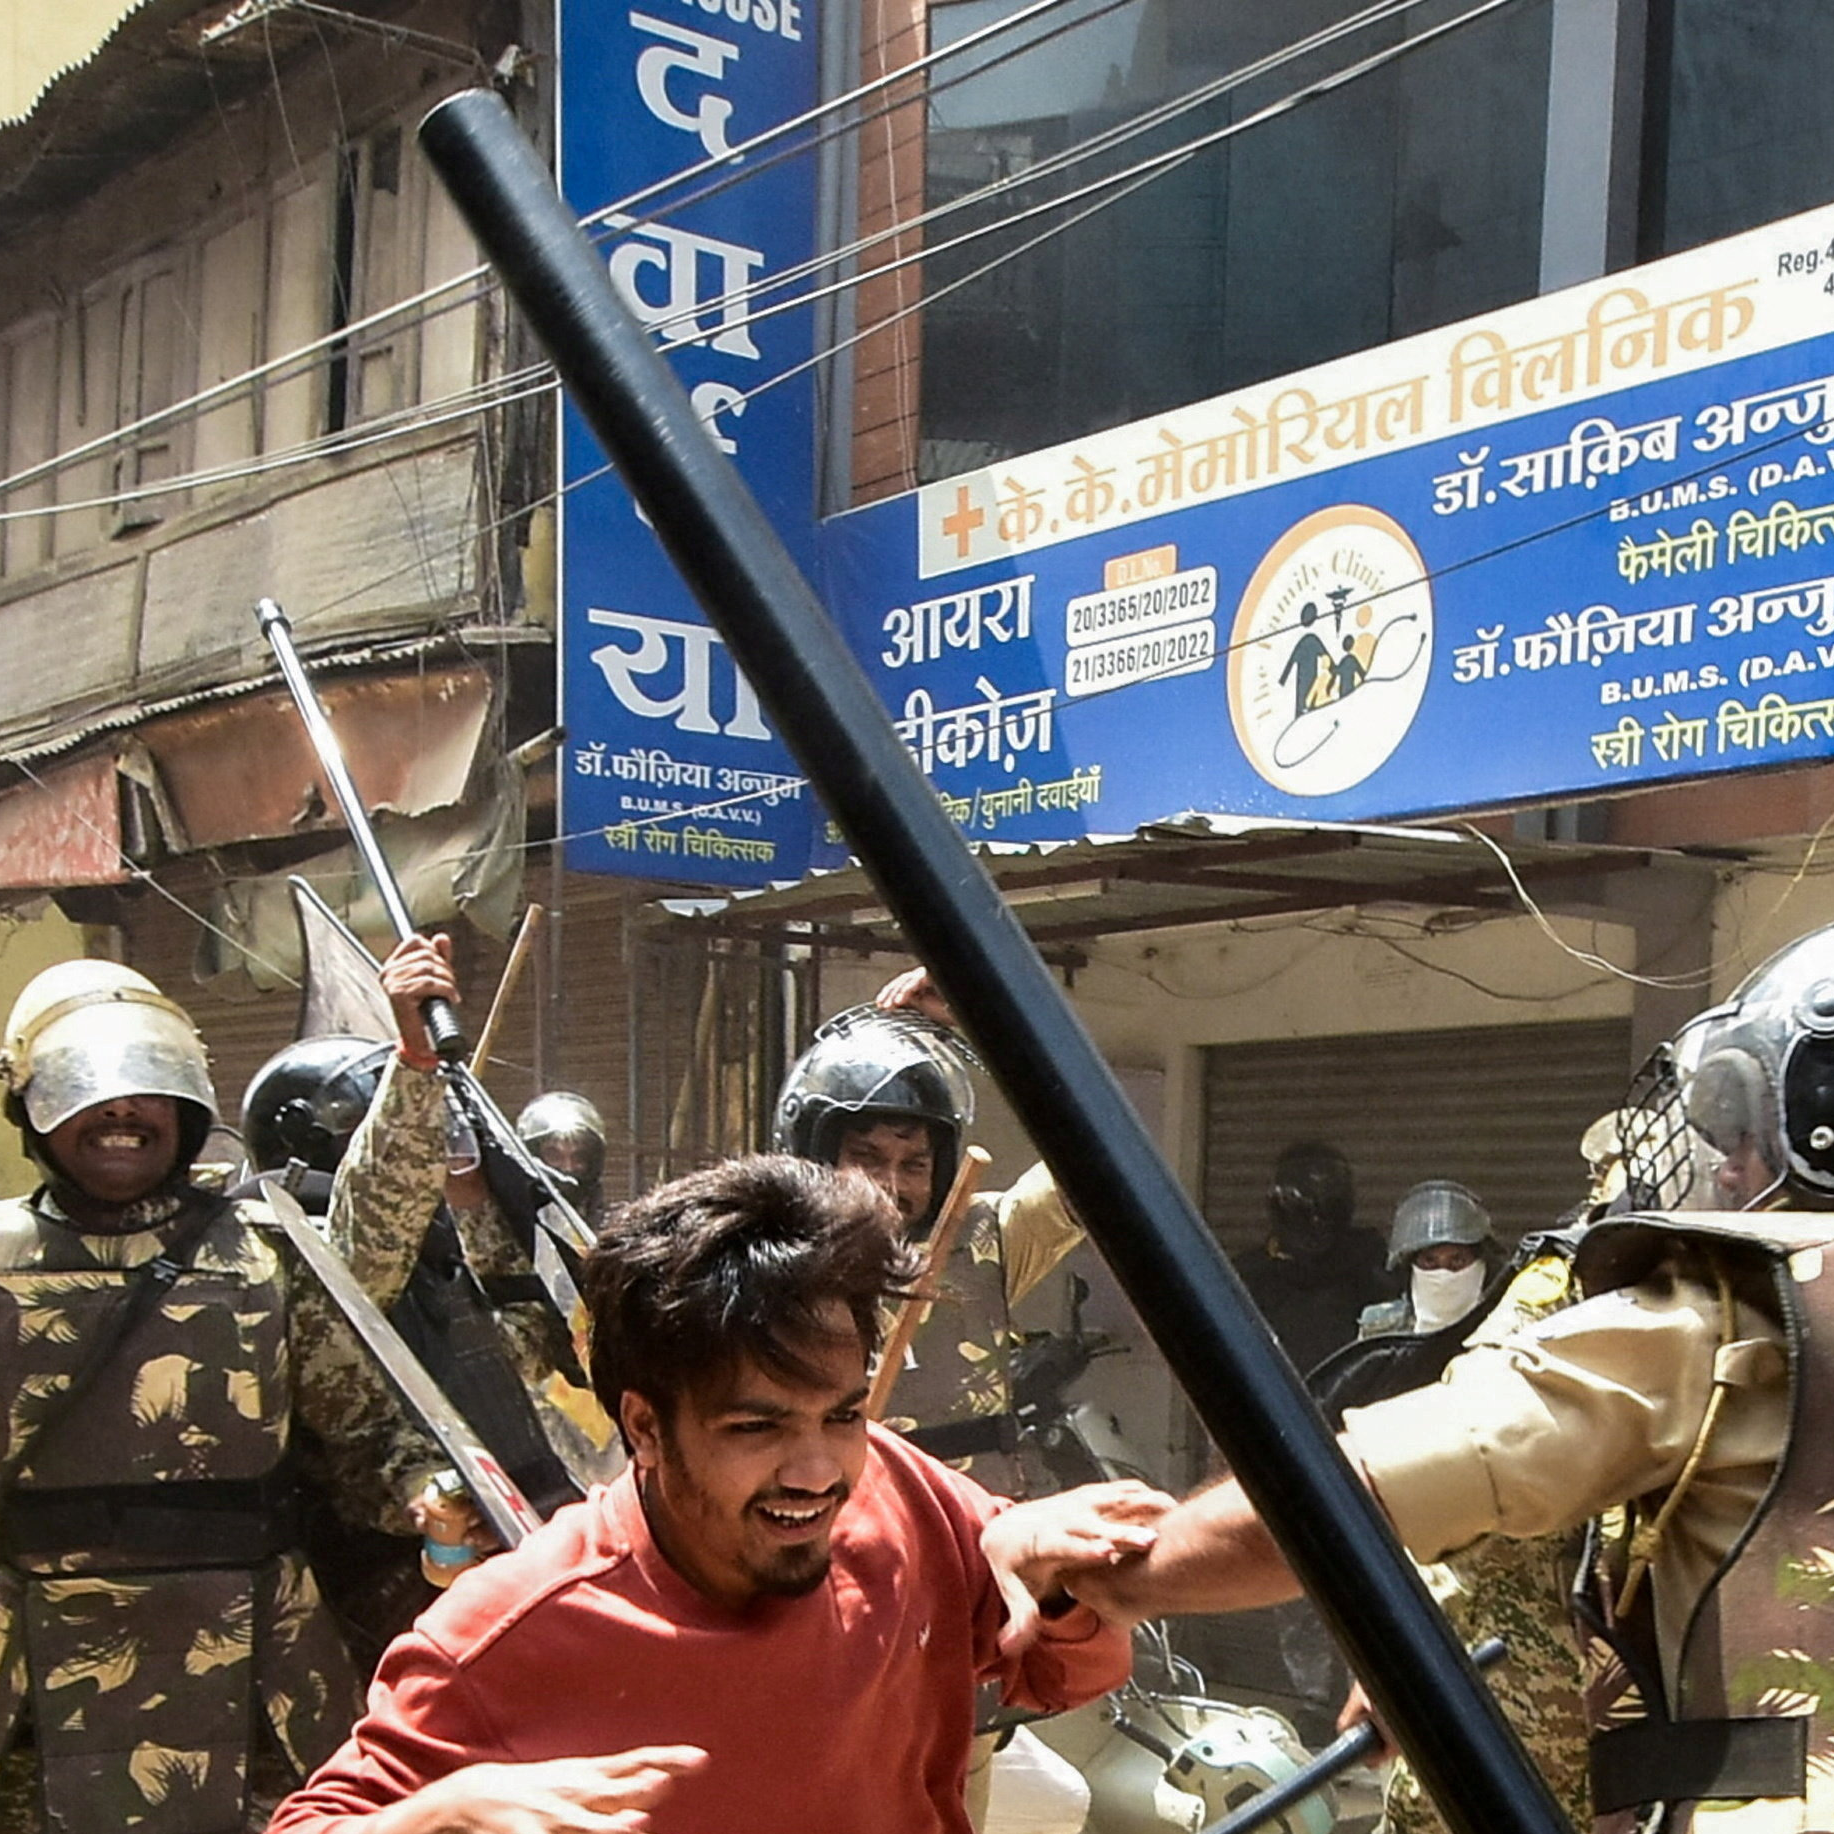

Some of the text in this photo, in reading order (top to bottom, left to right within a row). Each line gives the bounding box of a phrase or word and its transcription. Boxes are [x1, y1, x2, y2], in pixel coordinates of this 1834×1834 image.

[1609, 475, 1738, 523] B.U.M.S.
[1617, 519, 1718, 585] फैमेली
[881, 574, 1036, 668] आयरा
[1073, 577, 1210, 633] 20/3365/20/2022
[1073, 631, 1209, 684] 21/3366/20/2022
[1453, 604, 1697, 684] डॉ.फौज़िया
[1601, 666, 1729, 704] B.U.M.S.
[1591, 717, 1645, 769] स्त्री
[1652, 711, 1708, 761] रोग
[643, 824, 678, 856] रोग
[683, 825, 776, 864] चिकित्सक
